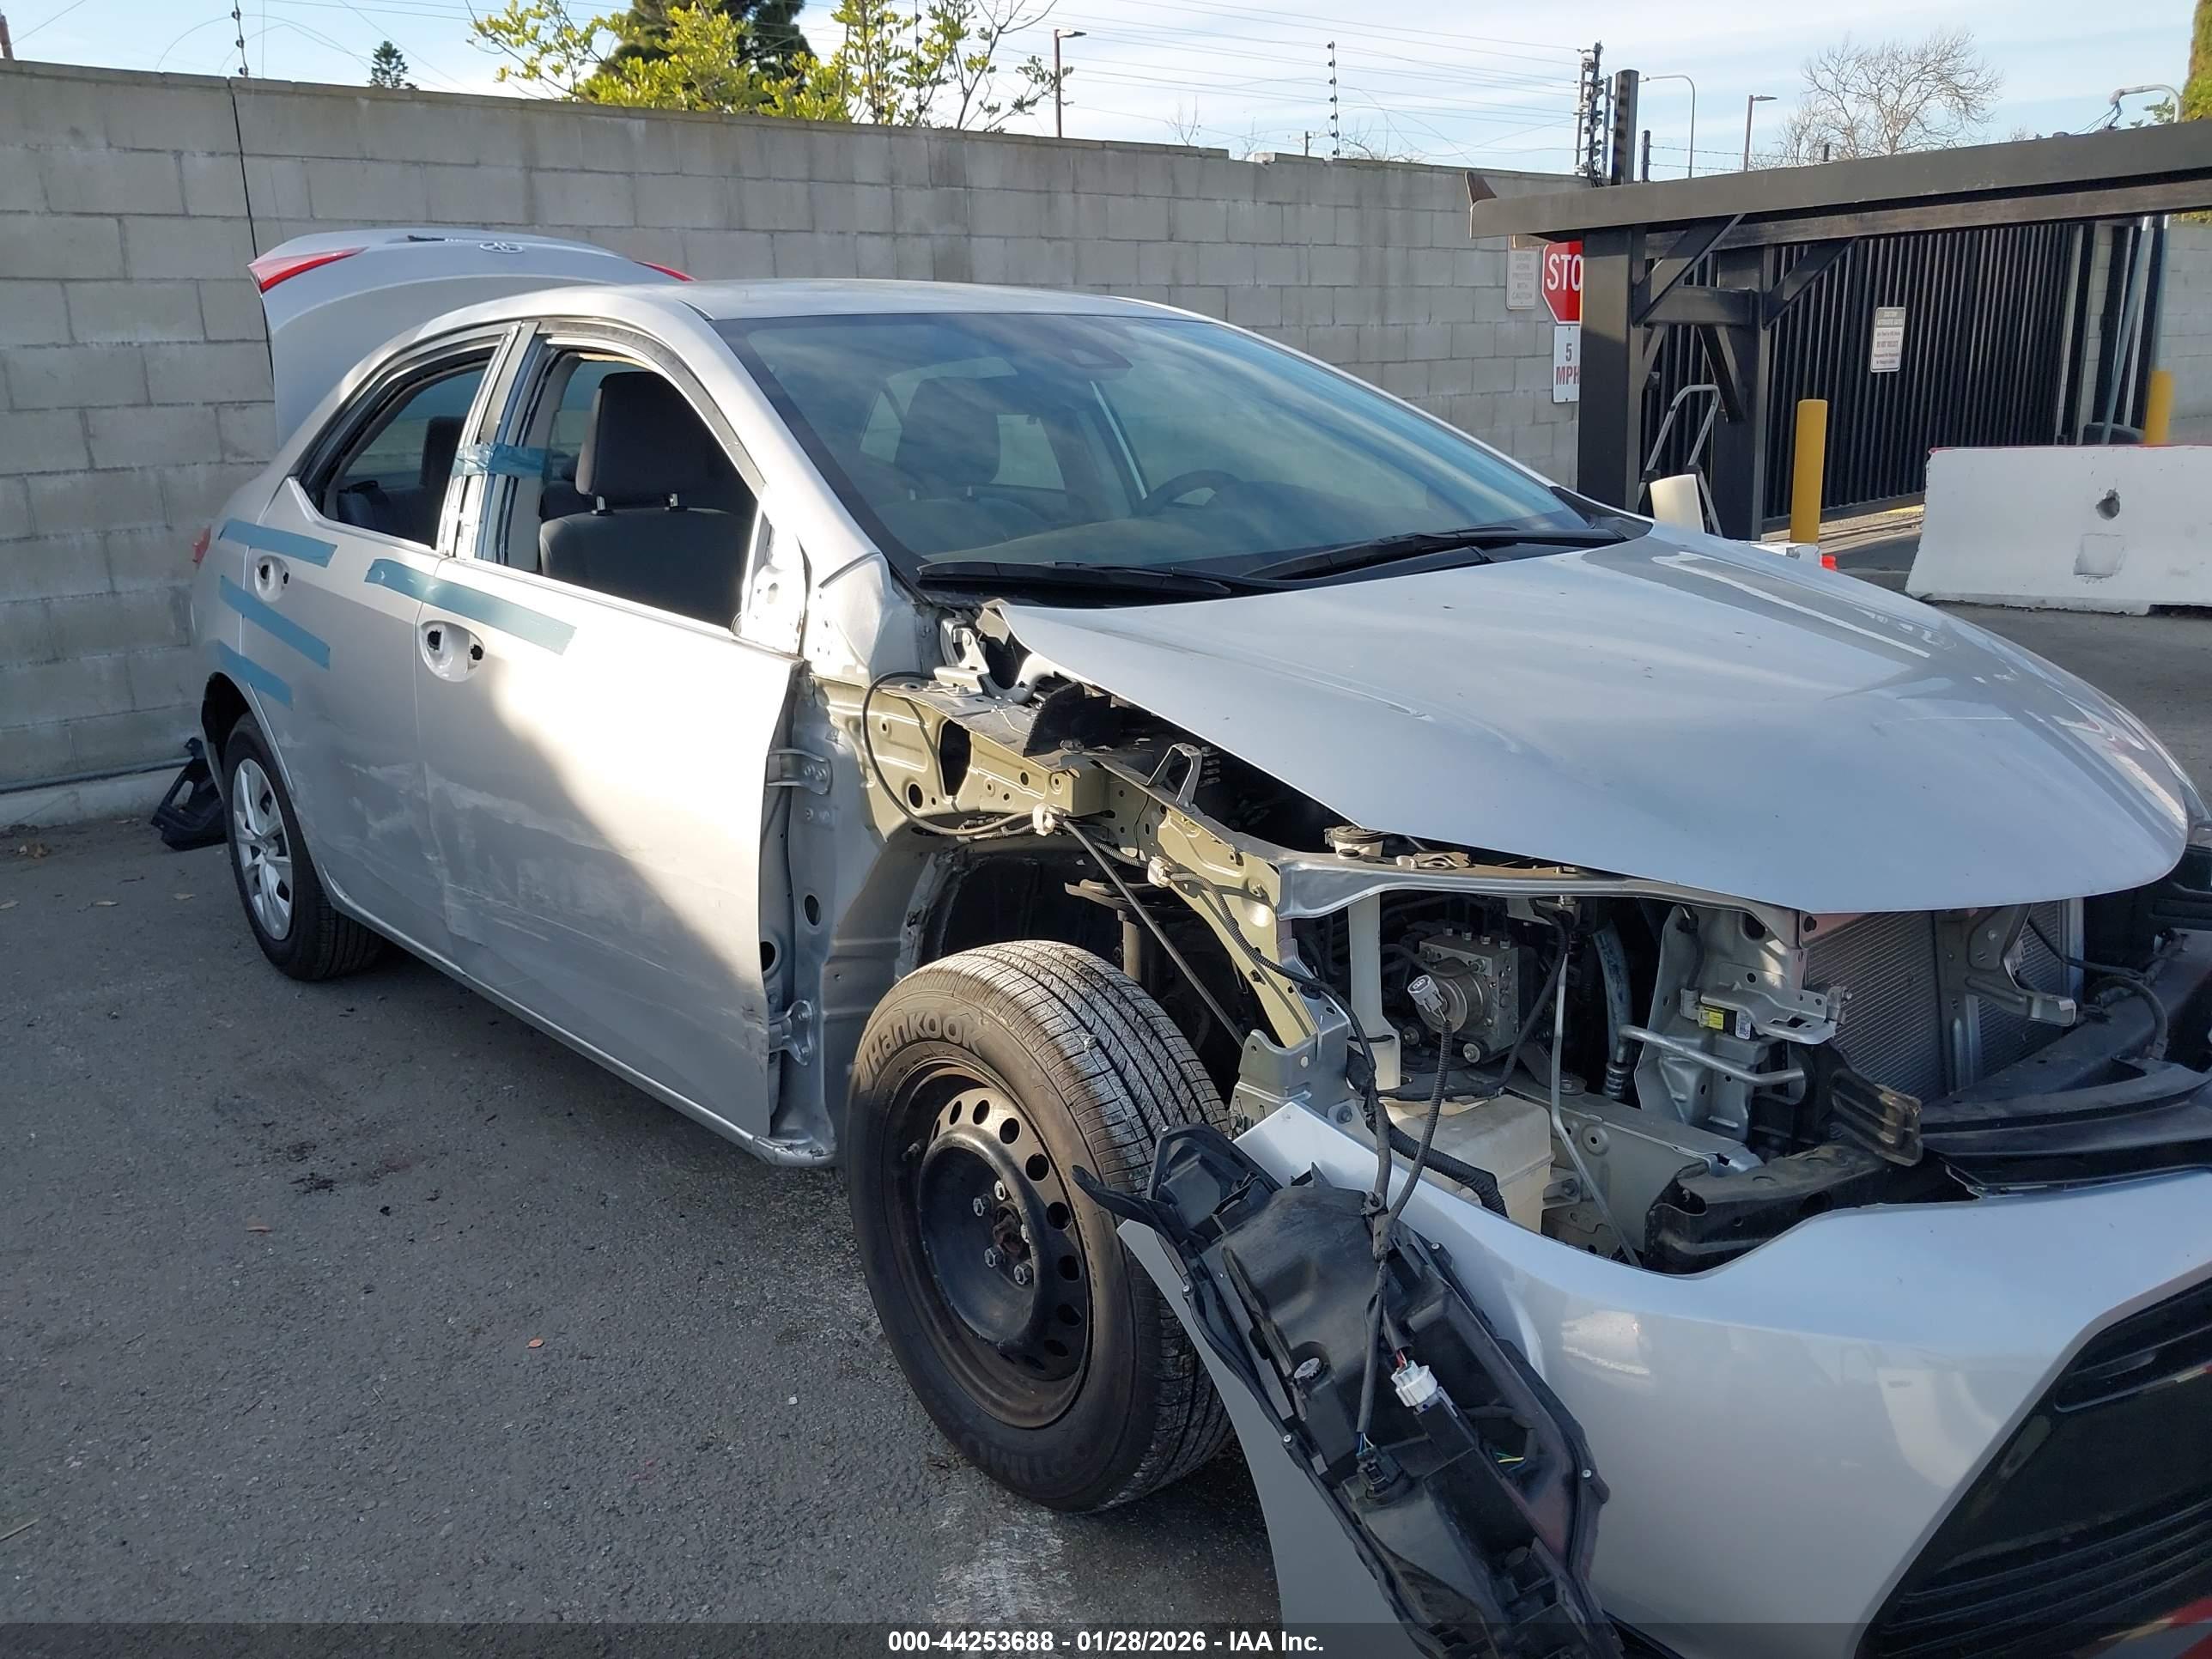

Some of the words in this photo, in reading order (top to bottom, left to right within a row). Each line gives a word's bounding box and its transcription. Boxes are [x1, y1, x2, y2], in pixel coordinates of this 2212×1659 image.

[1547, 253, 1583, 291] STO
[1565, 343, 1572, 362] 5
[1556, 366, 1580, 385] MPH
